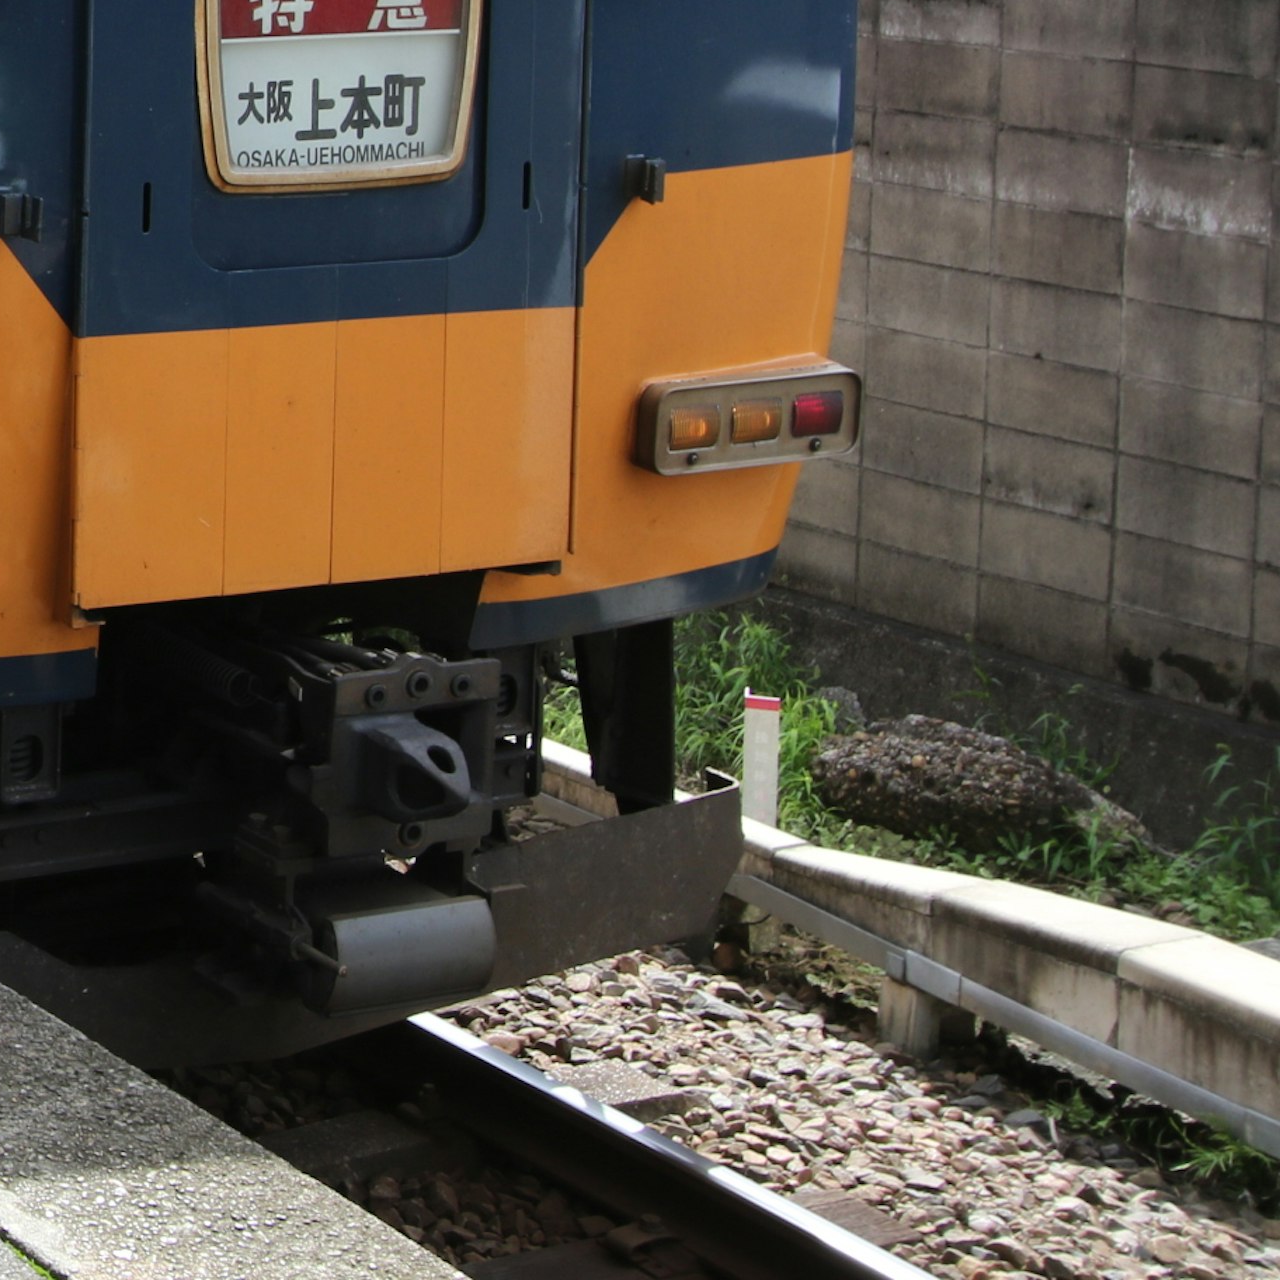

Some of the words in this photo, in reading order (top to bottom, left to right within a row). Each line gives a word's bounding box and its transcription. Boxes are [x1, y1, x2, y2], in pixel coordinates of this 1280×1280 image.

[237, 73, 426, 142] 大阪上本町
[237, 141, 425, 169] OSAKA-UEHOMMACHI
